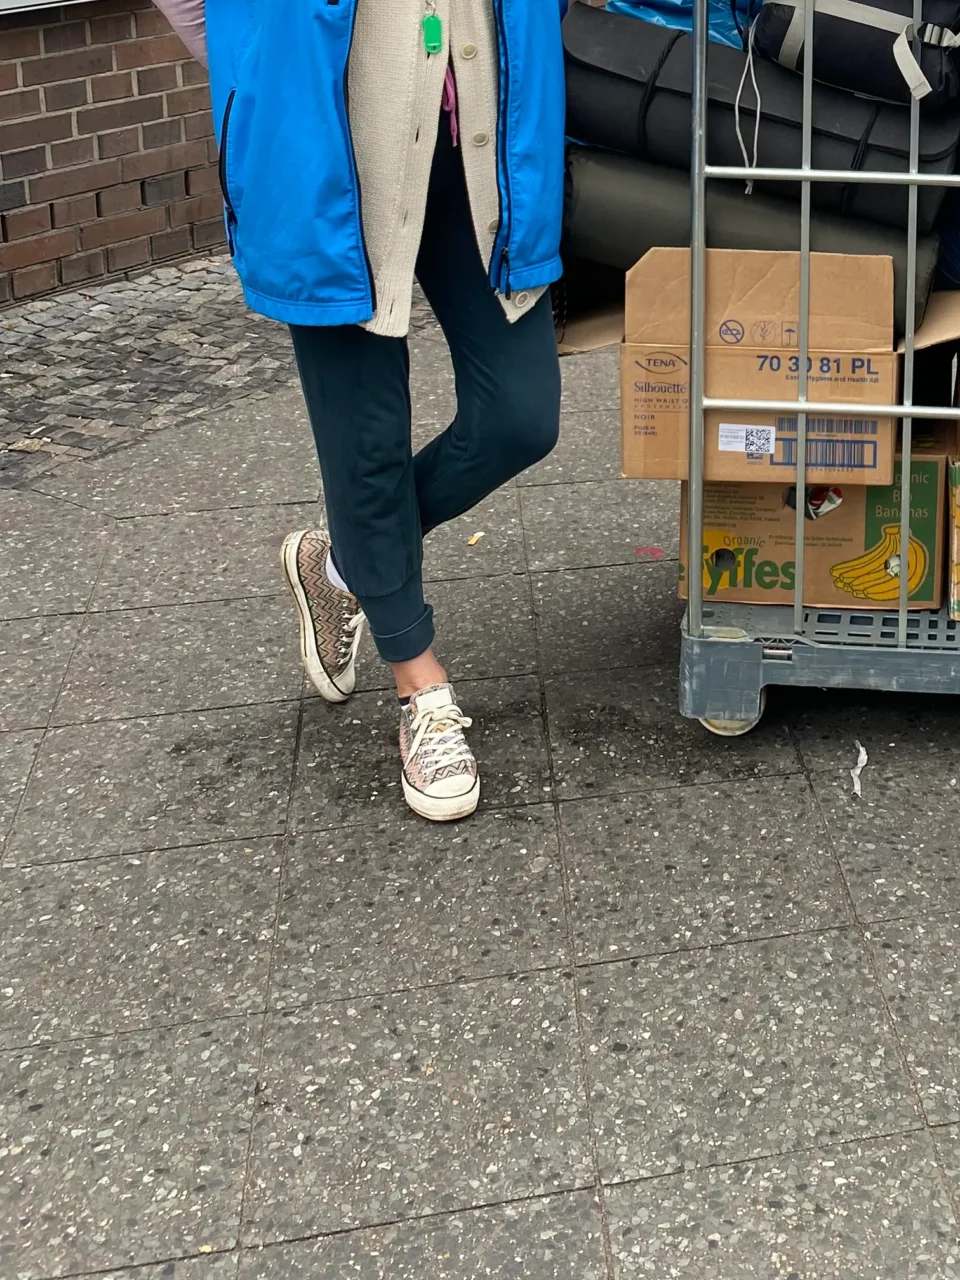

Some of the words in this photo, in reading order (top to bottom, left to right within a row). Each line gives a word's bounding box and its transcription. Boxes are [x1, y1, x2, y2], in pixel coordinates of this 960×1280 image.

[756, 355, 781, 372] 70
[819, 357, 841, 374] 81
[851, 357, 879, 375] PL
[633, 381, 688, 394] Silhouette
[893, 471, 930, 487] gnic
[875, 505, 929, 519] Bannas
[723, 535, 767, 549] Organic
